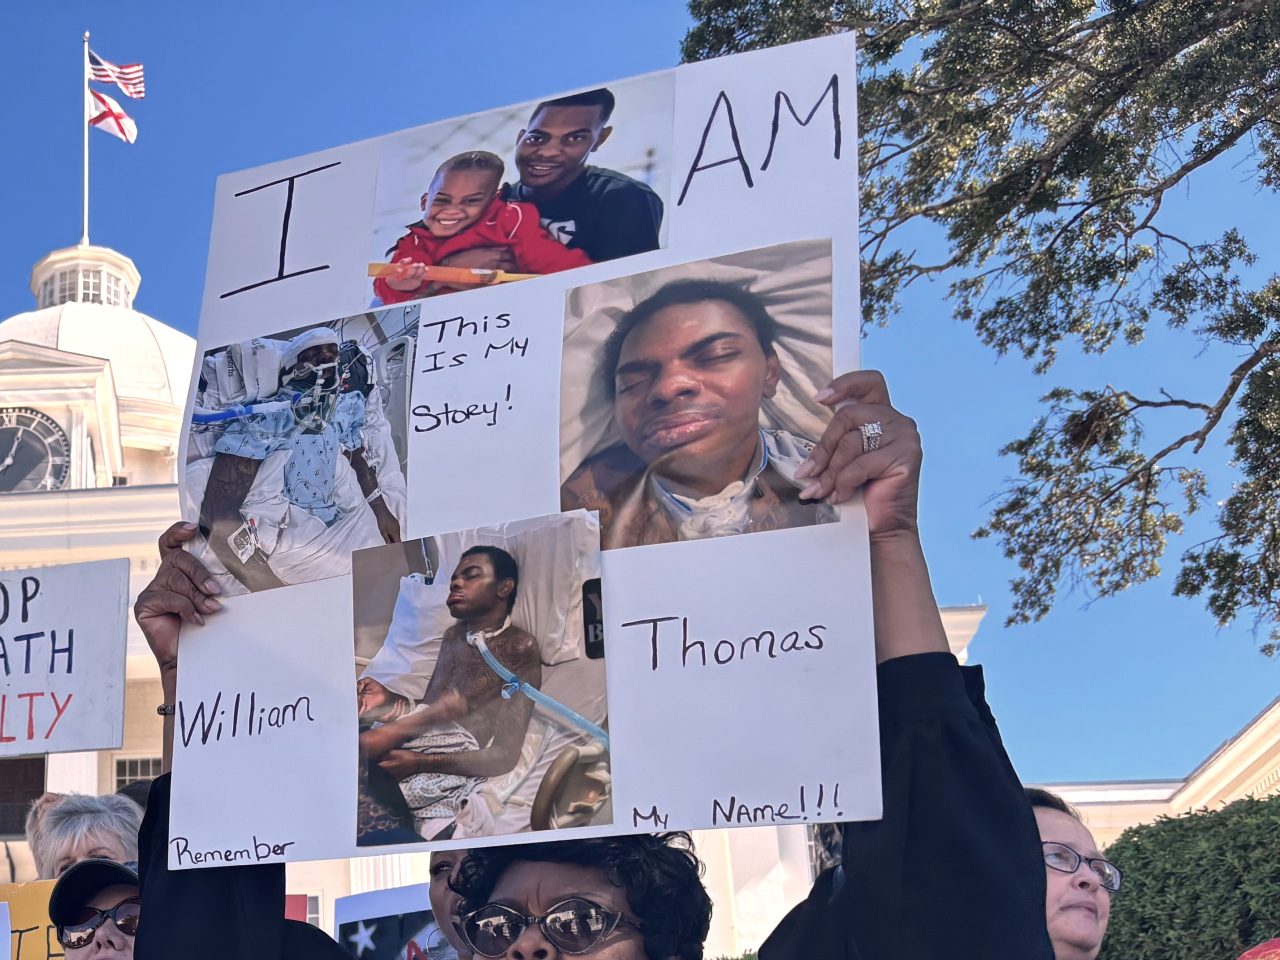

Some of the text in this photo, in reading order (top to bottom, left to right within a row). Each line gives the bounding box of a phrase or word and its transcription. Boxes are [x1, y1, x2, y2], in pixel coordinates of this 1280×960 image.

[677, 74, 841, 206] AM
[422, 351, 468, 373] Is
[423, 313, 511, 343] This
[179, 616, 827, 748] William Thomas
